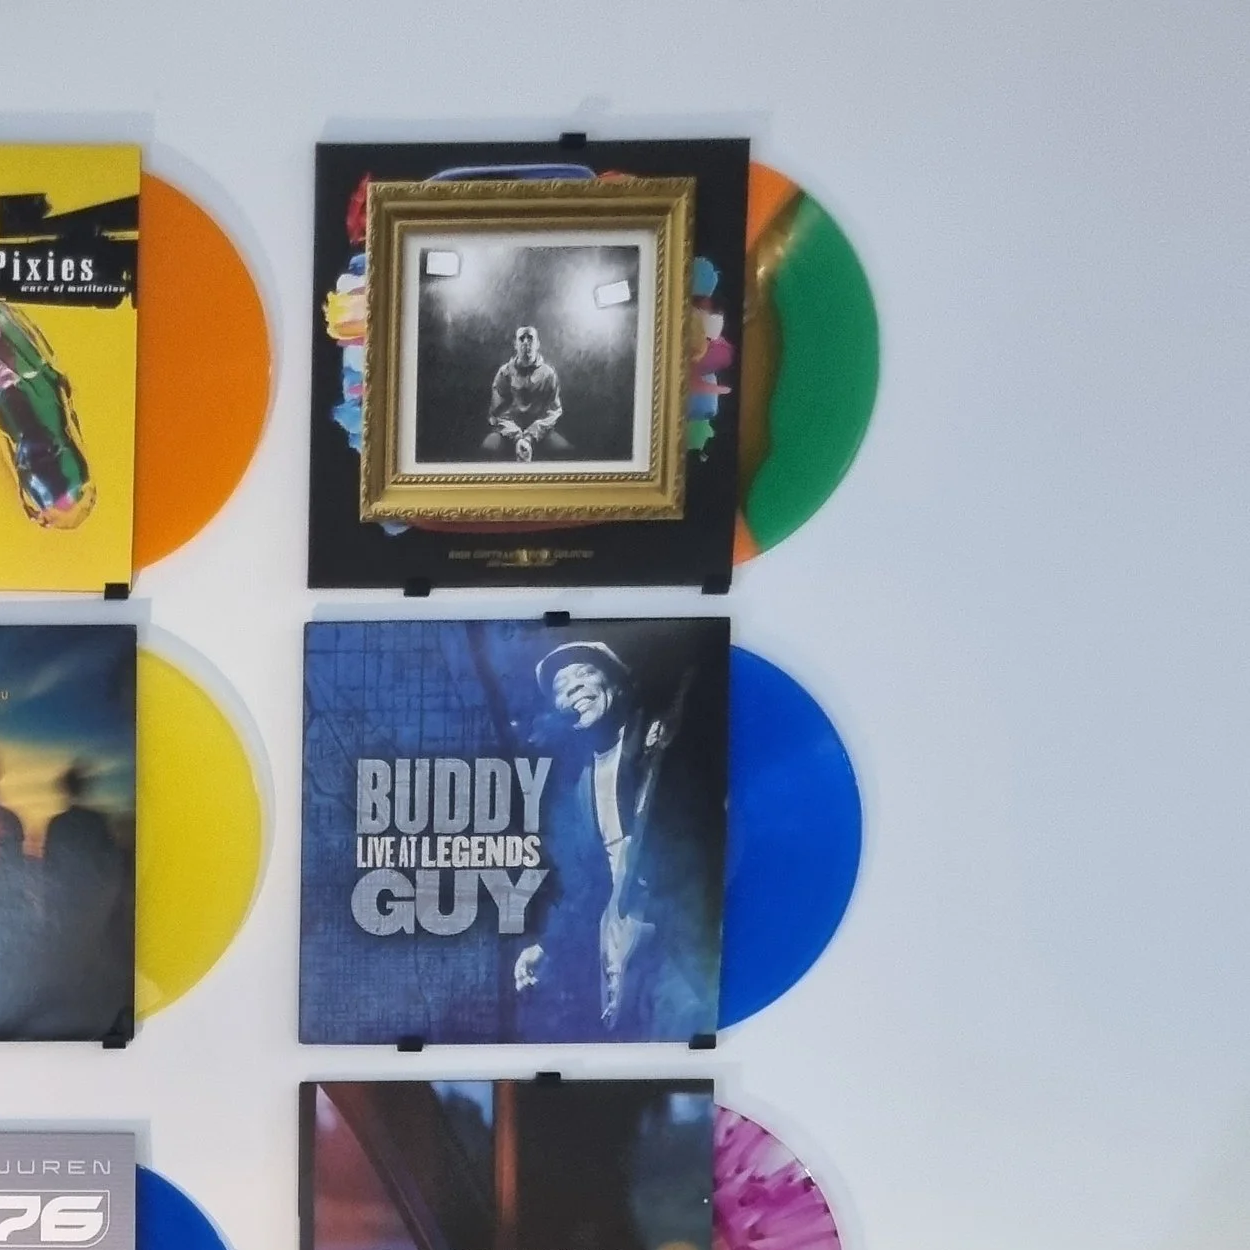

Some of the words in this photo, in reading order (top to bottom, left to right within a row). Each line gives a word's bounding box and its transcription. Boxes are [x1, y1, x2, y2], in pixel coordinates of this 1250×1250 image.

[53, 284, 64, 293] of
[356, 757, 553, 835] BUDDY
[356, 836, 396, 868] LIVE
[399, 836, 417, 868] AT
[421, 835, 541, 868] LEGENDS
[351, 868, 550, 936] GUY
